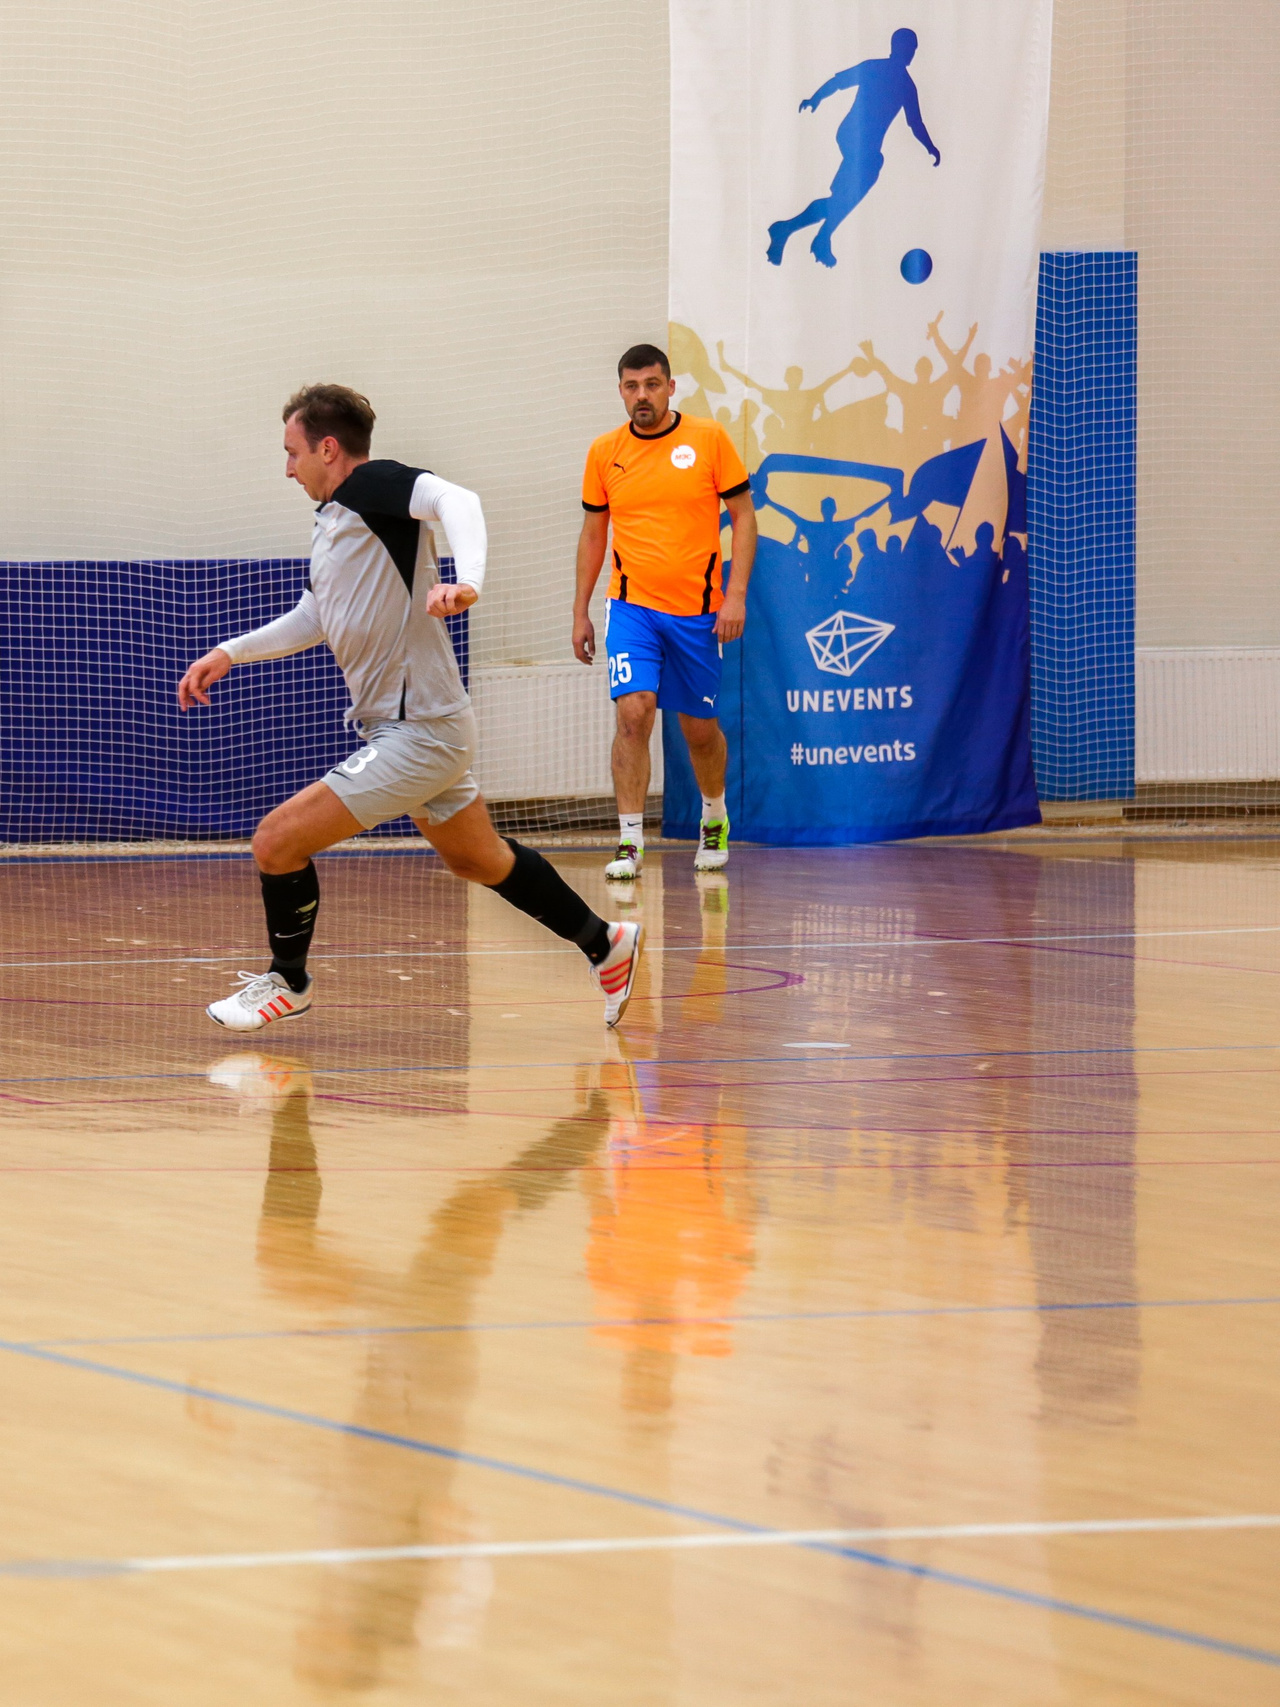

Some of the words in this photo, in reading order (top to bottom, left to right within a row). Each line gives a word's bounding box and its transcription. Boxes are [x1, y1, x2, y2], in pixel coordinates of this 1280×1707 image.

[608, 652, 632, 688] 25
[786, 685, 913, 712] UNEVENTS
[790, 739, 916, 766] #unevents
